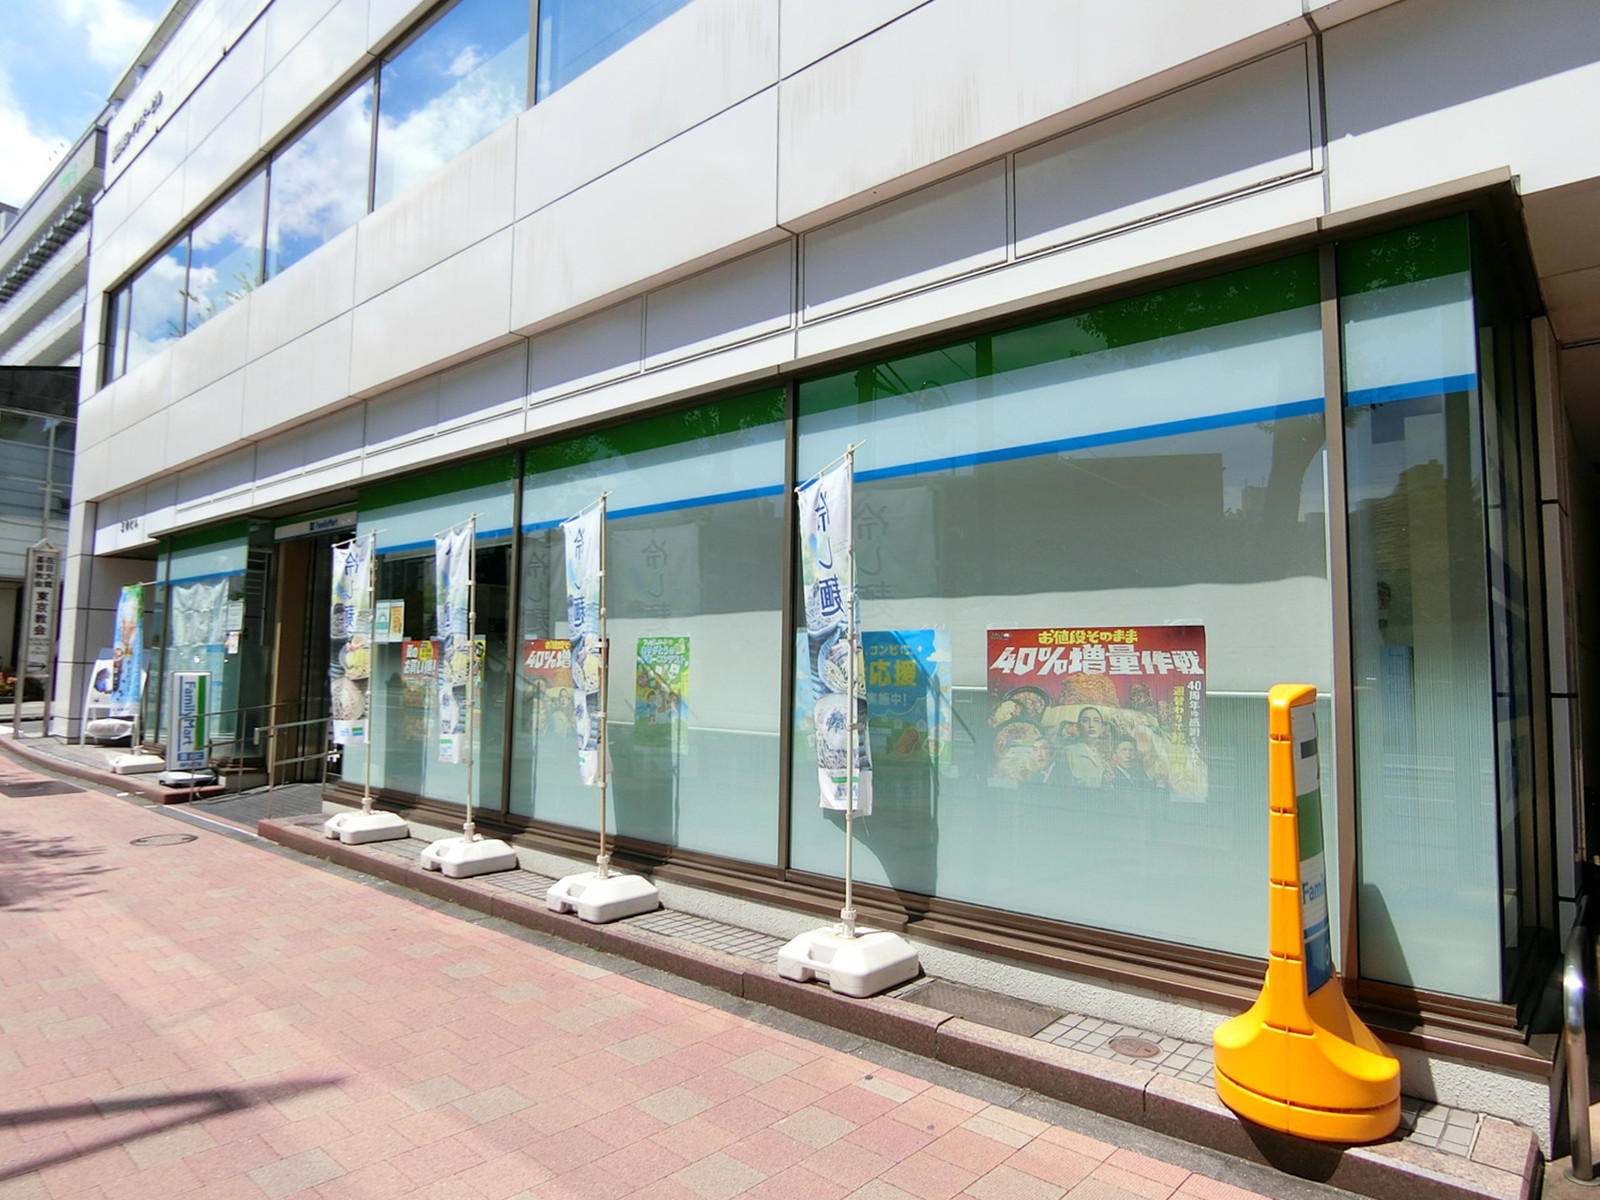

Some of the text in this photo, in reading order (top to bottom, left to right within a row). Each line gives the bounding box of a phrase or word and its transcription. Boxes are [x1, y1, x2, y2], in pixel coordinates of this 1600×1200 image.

[33, 591, 49, 636] 東京教会
[1038, 629, 1138, 645] お値段そのまま
[525, 649, 572, 669] 40%増
[989, 644, 1204, 675] 40%増量作戦
[182, 681, 196, 746] FamilyMart
